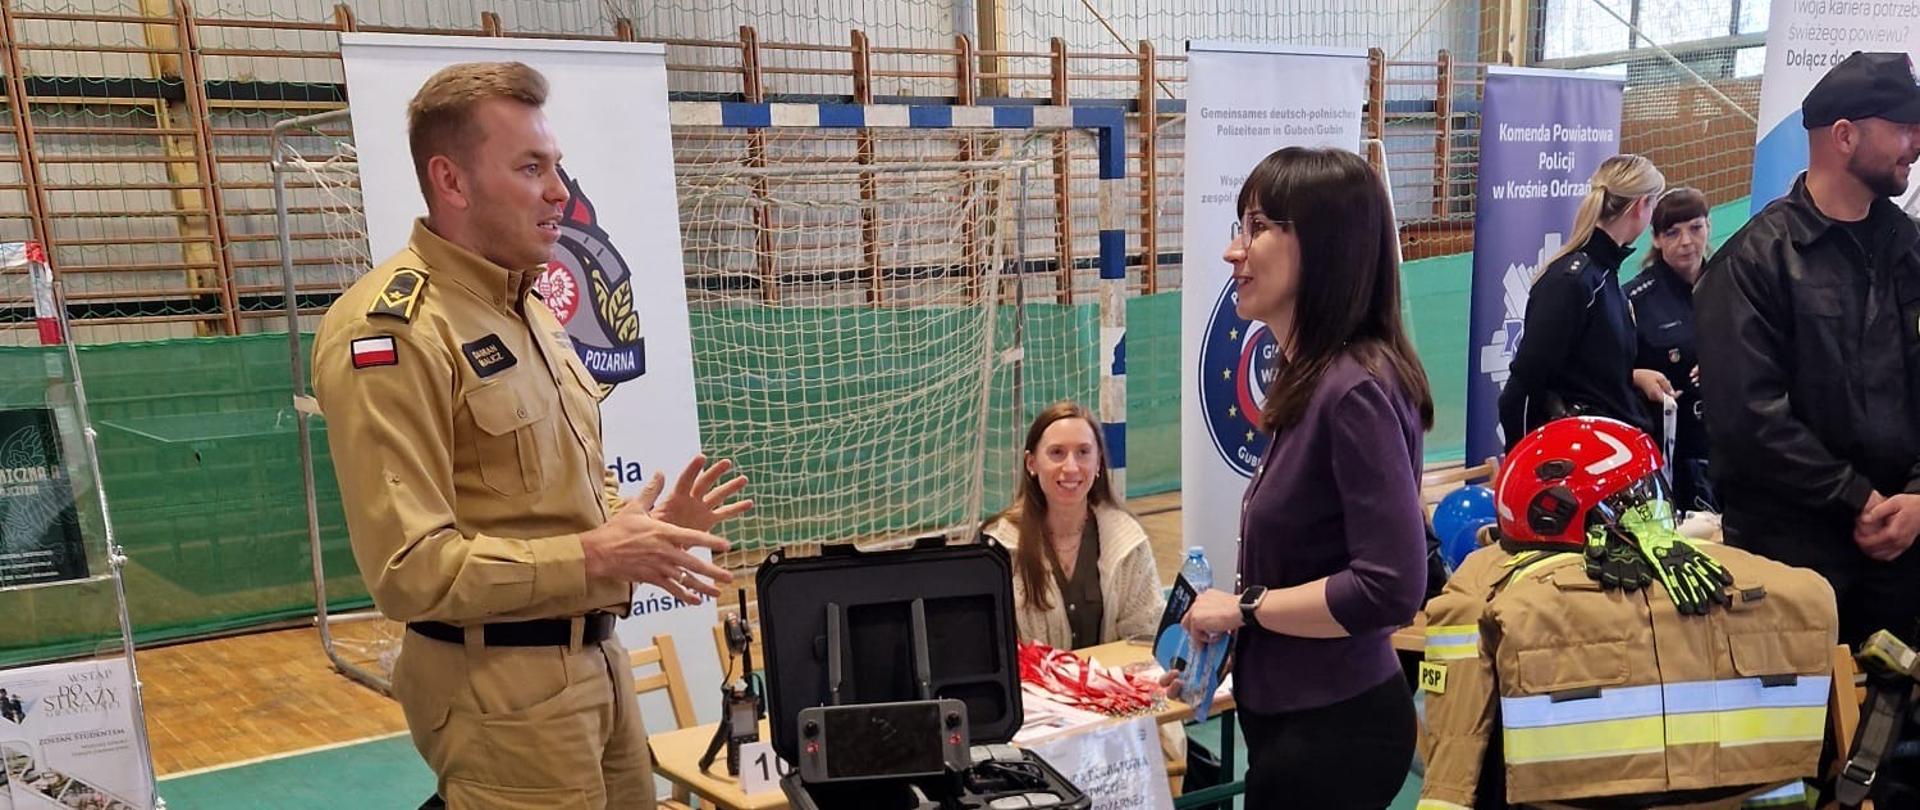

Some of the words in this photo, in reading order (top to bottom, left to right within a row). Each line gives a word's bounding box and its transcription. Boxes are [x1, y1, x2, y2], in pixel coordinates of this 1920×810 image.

[1794, 0, 1825, 19] Twoja
[1829, 0, 1870, 16] kariera
[1873, 0, 1920, 20] potrzeb
[1788, 22, 1846, 45] świeżego
[1849, 26, 1909, 44] powiewu?
[1787, 49, 1827, 70] Dołącz
[1201, 107, 1267, 119] Gemeinsames
[1270, 107, 1356, 121] deutsch-polnisches
[1217, 124, 1271, 136] Polizeiteam
[1273, 125, 1281, 135] in
[1284, 124, 1343, 136] Guben/Gubin
[1499, 123, 1551, 142] Komenda
[1553, 123, 1613, 142] Powiatowa
[1539, 152, 1575, 172] Policji
[1220, 174, 1247, 188] Wspó
[1493, 186, 1504, 199] w
[1507, 180, 1548, 199] Krośnie
[1550, 178, 1592, 198] Odrzań
[1422, 668, 1441, 687] PSP
